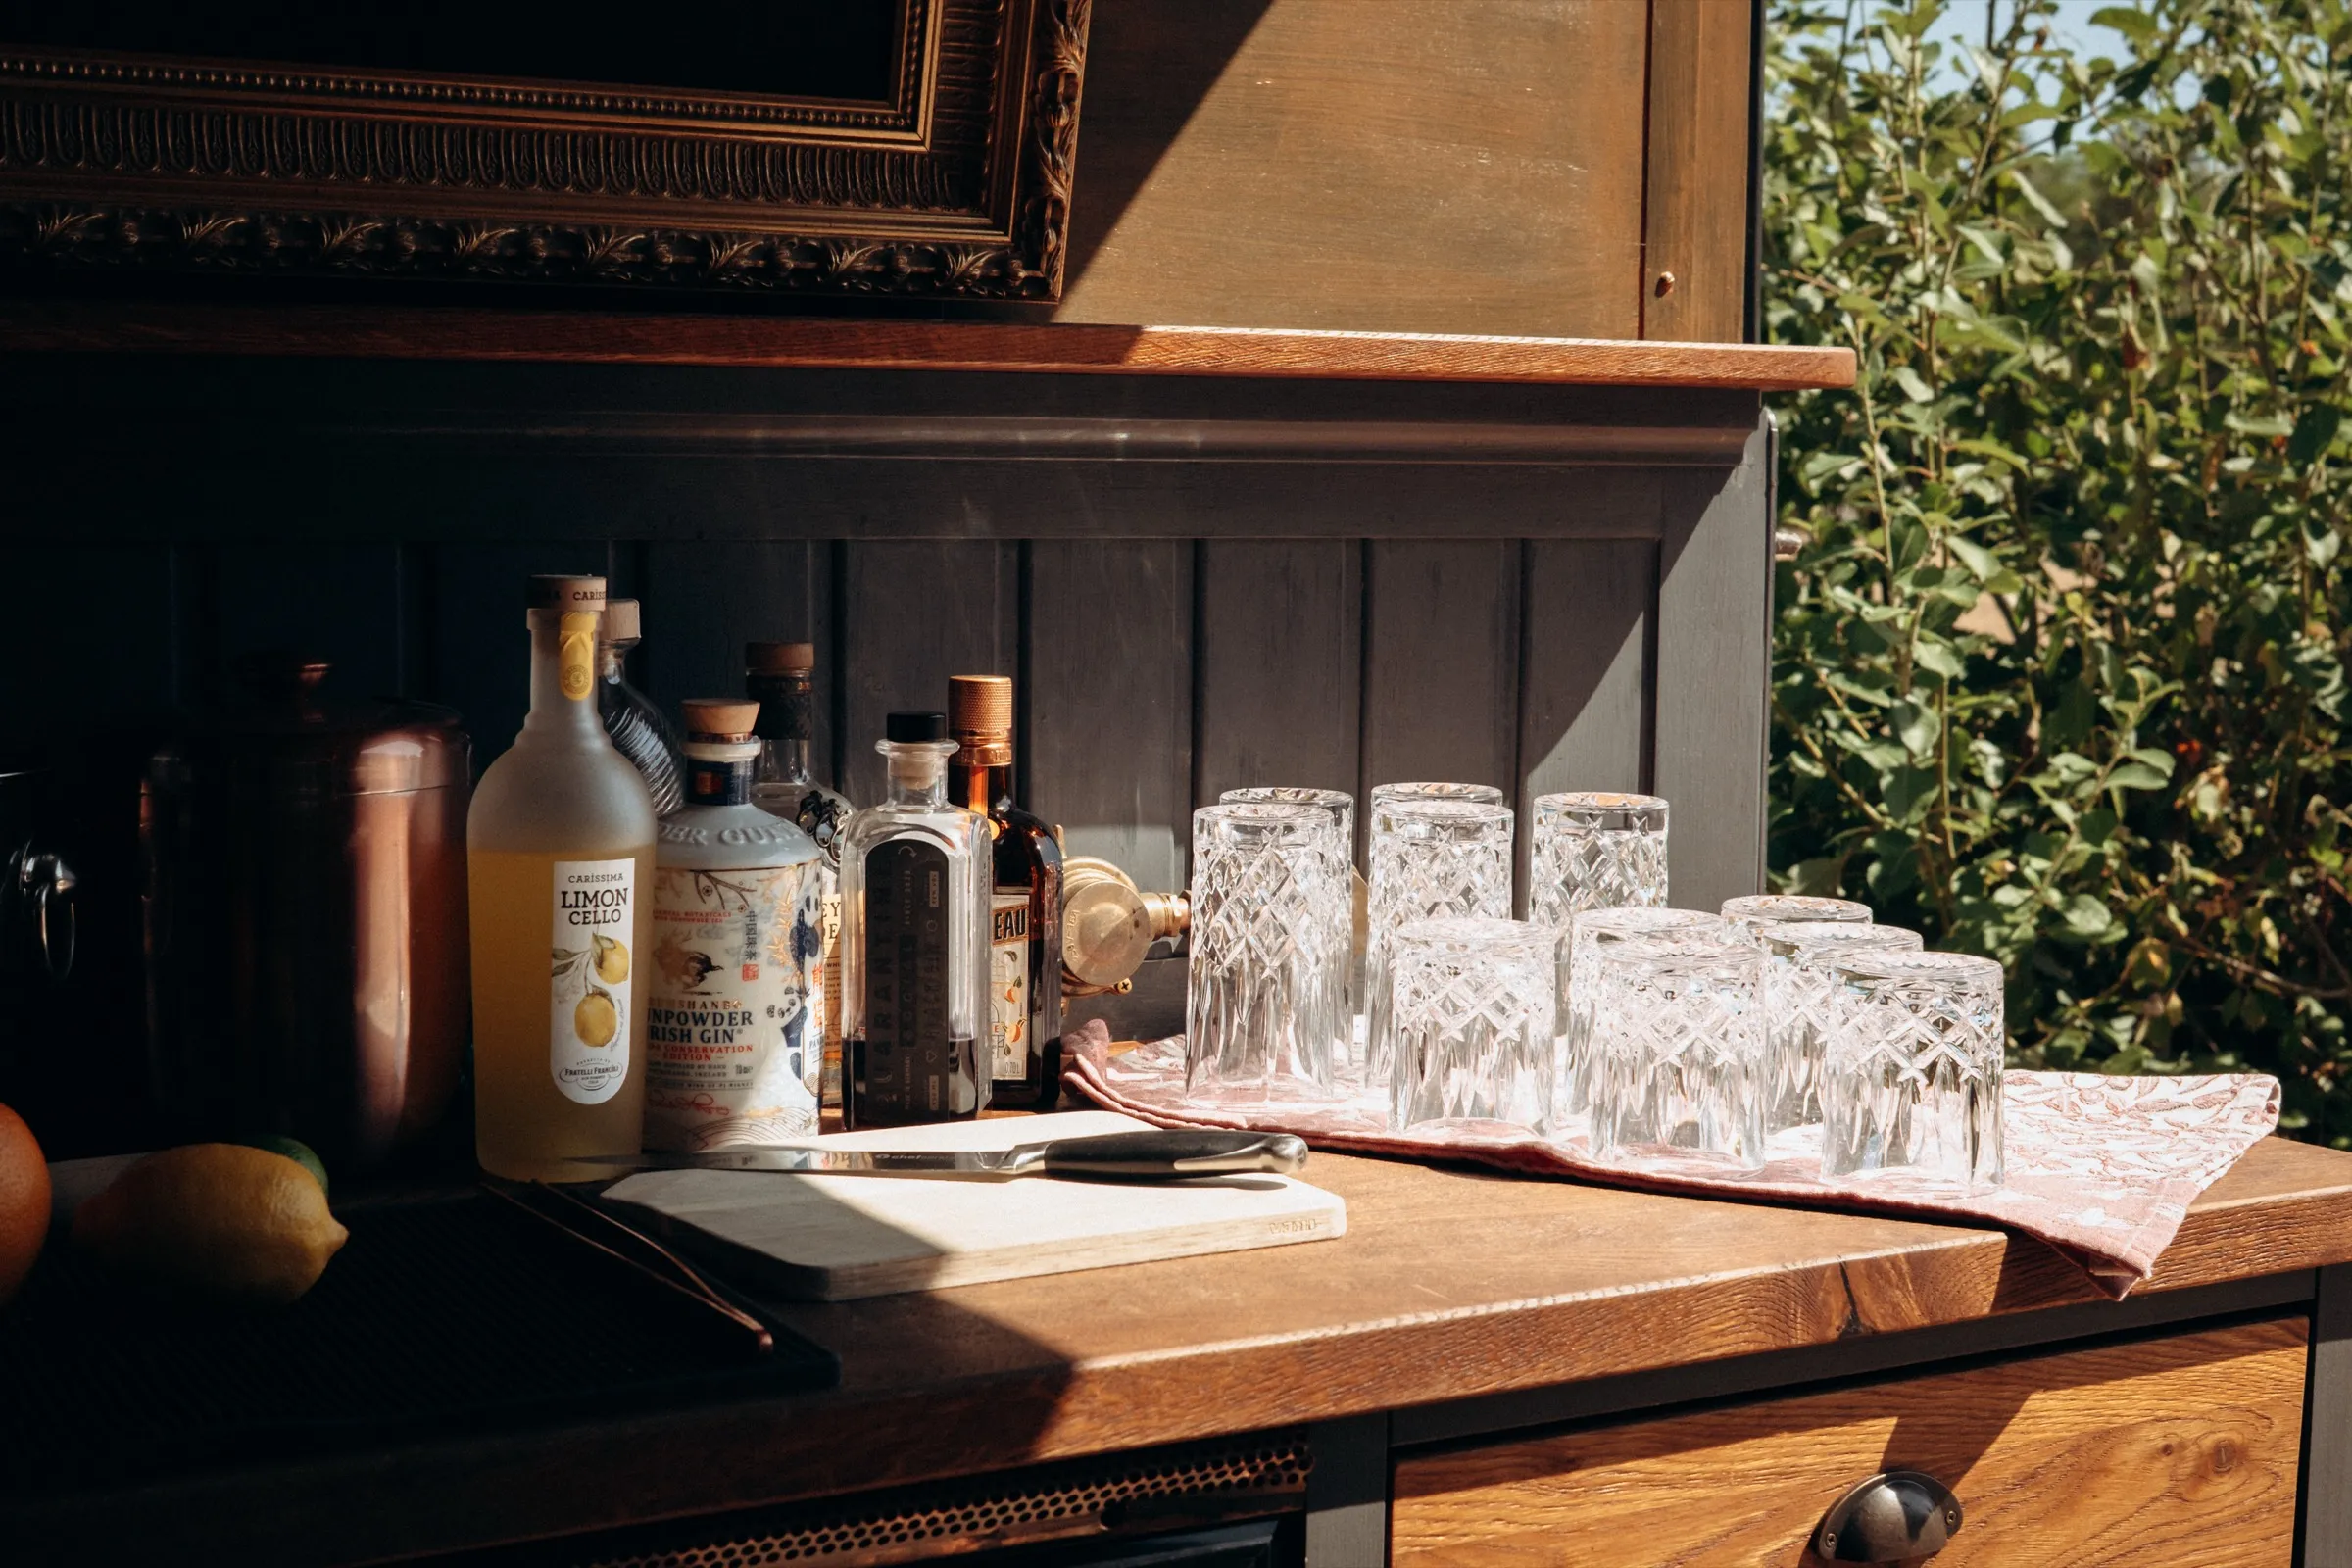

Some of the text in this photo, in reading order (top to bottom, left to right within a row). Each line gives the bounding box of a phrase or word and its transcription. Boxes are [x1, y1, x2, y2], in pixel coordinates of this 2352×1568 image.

[561, 887, 628, 909] LIMON
[568, 908, 621, 926] CELLO
[994, 908, 1027, 941] EAU
[662, 1052, 711, 1061] EDITION
[664, 1044, 754, 1054] CONSERVATION
